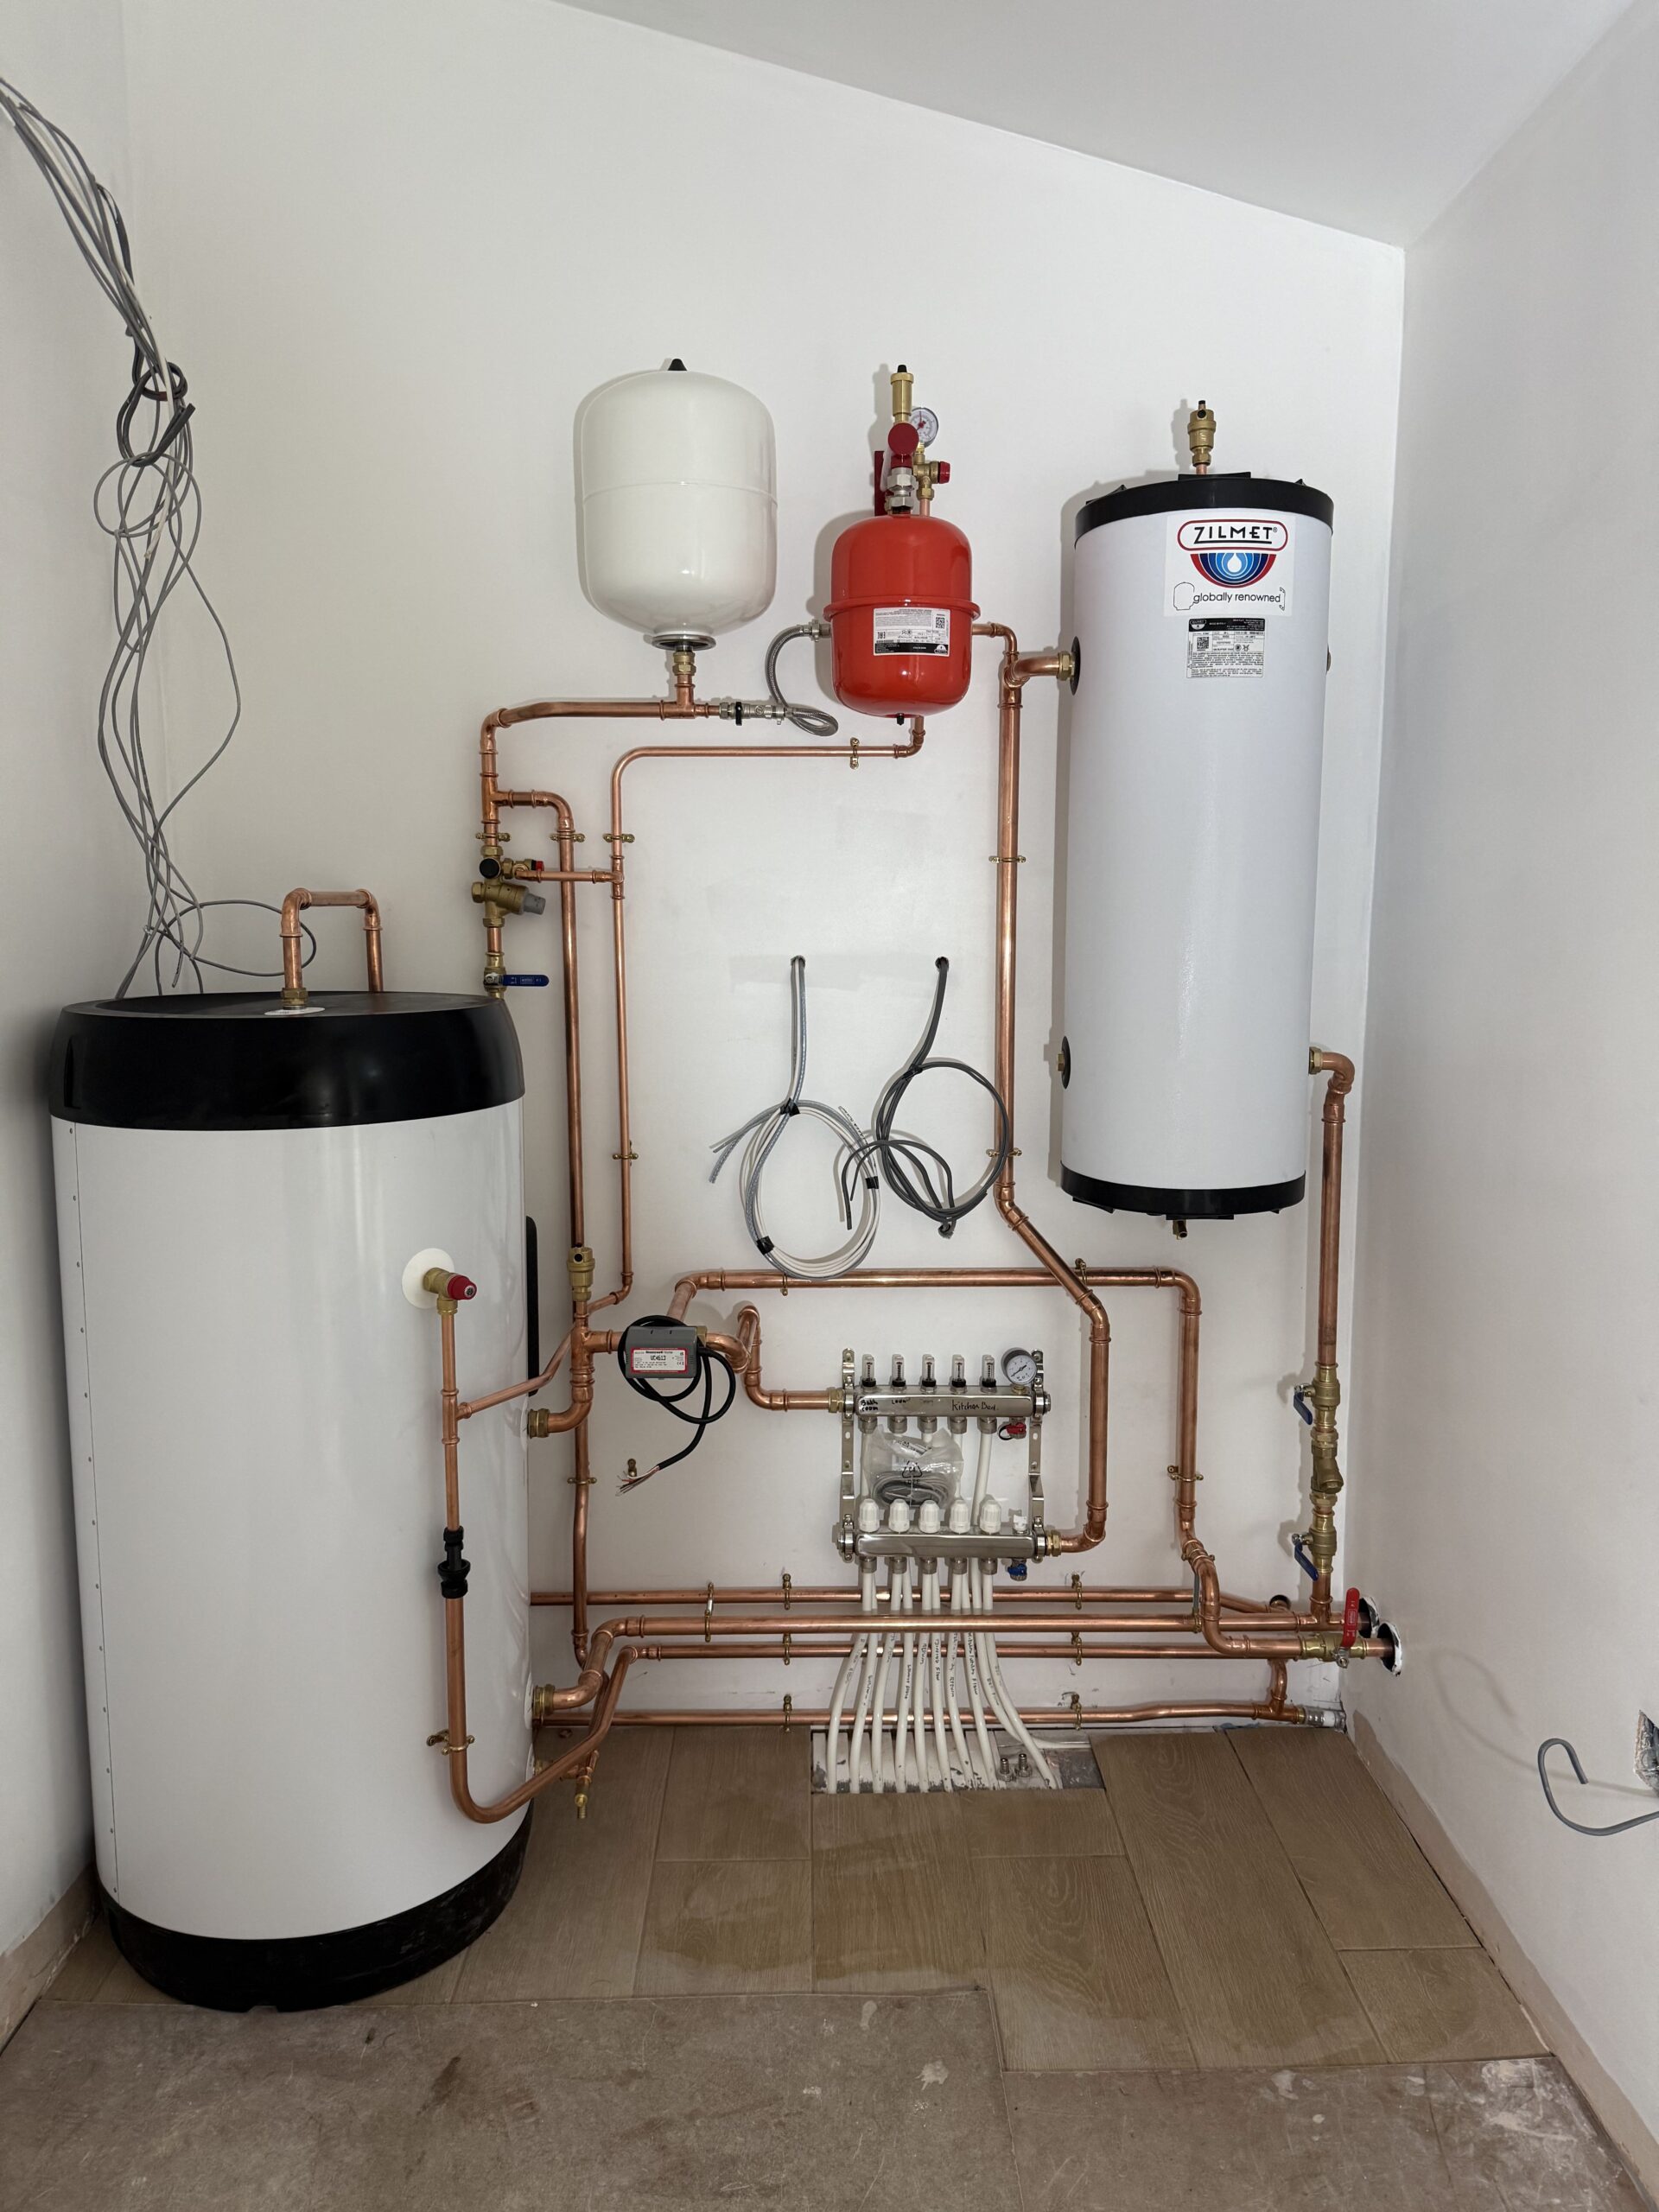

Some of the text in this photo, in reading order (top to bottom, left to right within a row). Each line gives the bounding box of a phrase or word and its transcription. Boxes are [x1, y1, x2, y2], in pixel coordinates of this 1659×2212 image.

[1194, 526, 1273, 544] ZILMET
[1193, 592, 1281, 604] globally renowned
